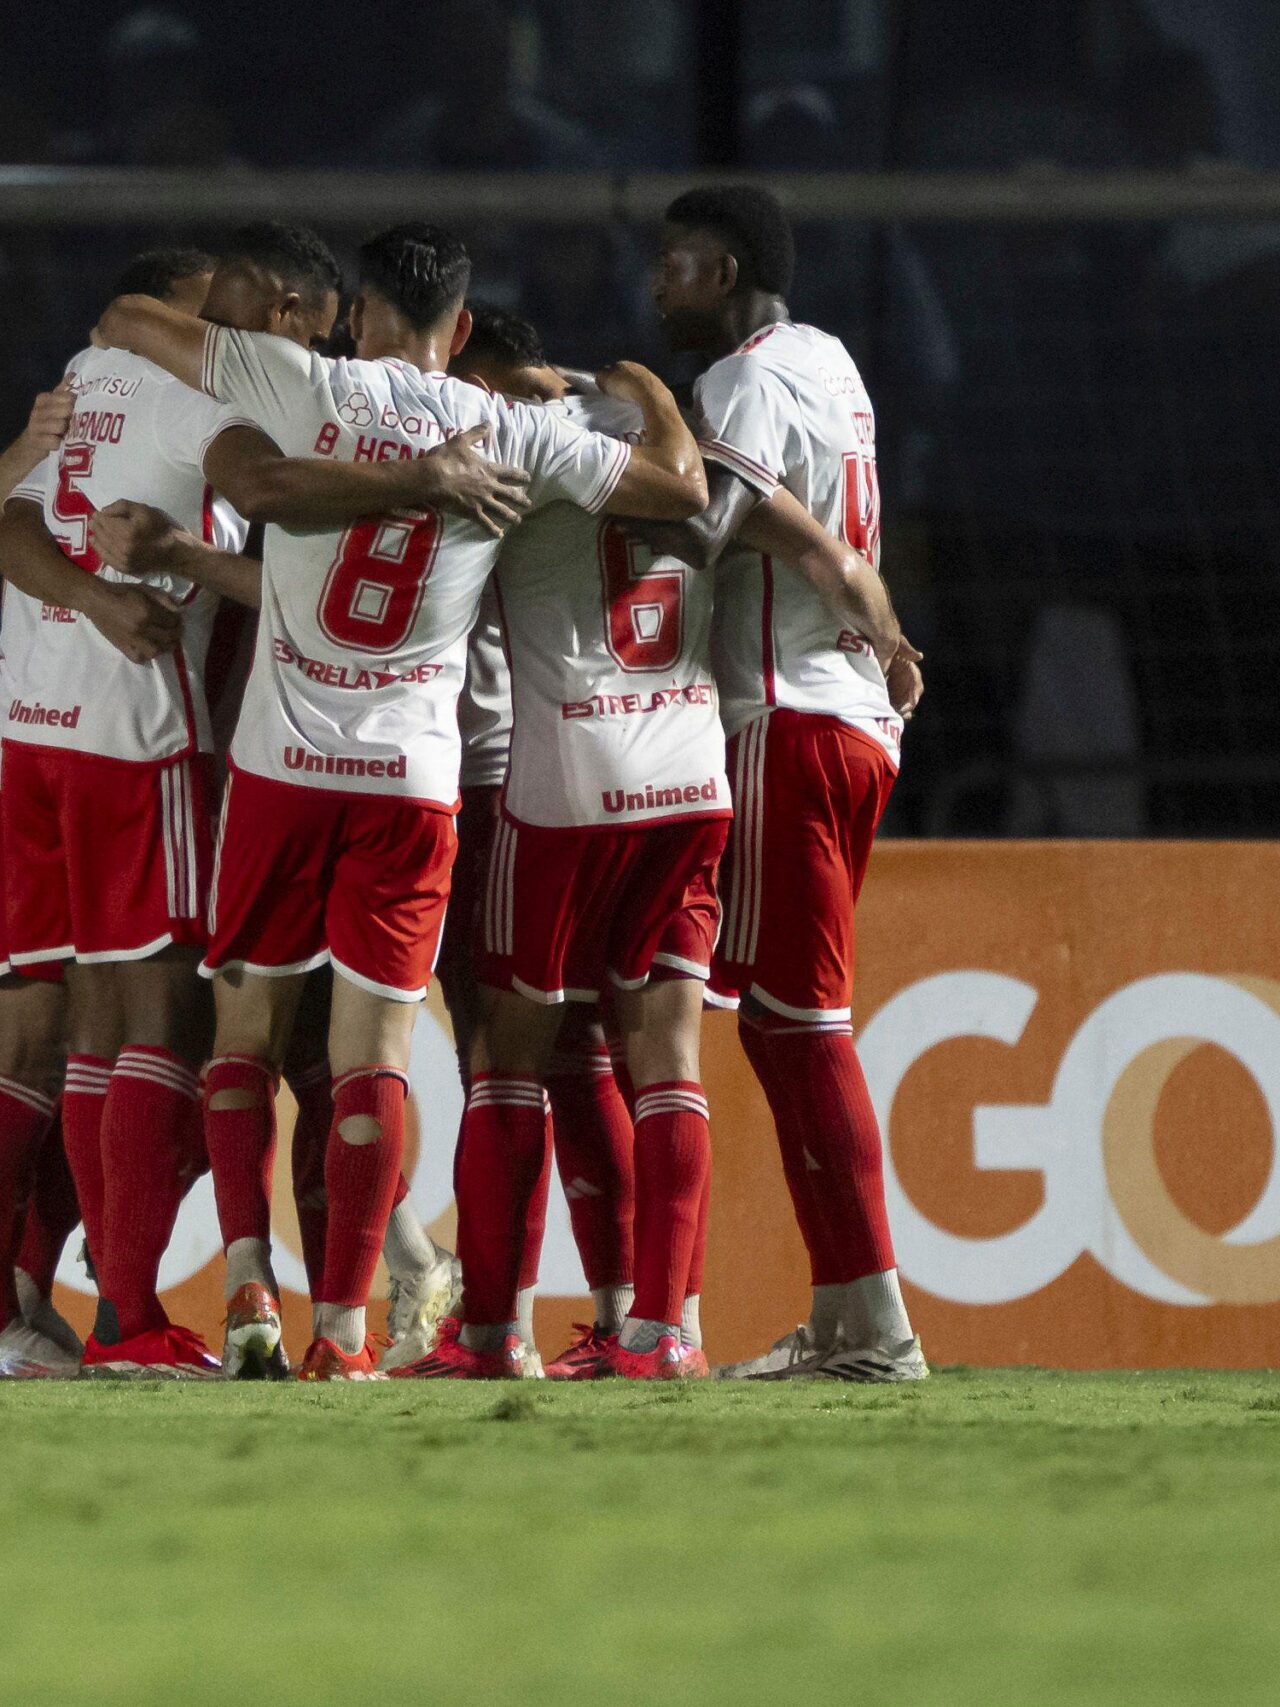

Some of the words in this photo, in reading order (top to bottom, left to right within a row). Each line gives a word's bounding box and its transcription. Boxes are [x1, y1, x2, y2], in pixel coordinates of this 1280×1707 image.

[317, 503, 444, 655] 8
[597, 515, 686, 674] 6
[8, 699, 82, 729] Unimed
[283, 746, 408, 779] Unimed
[601, 776, 718, 814] Unimed
